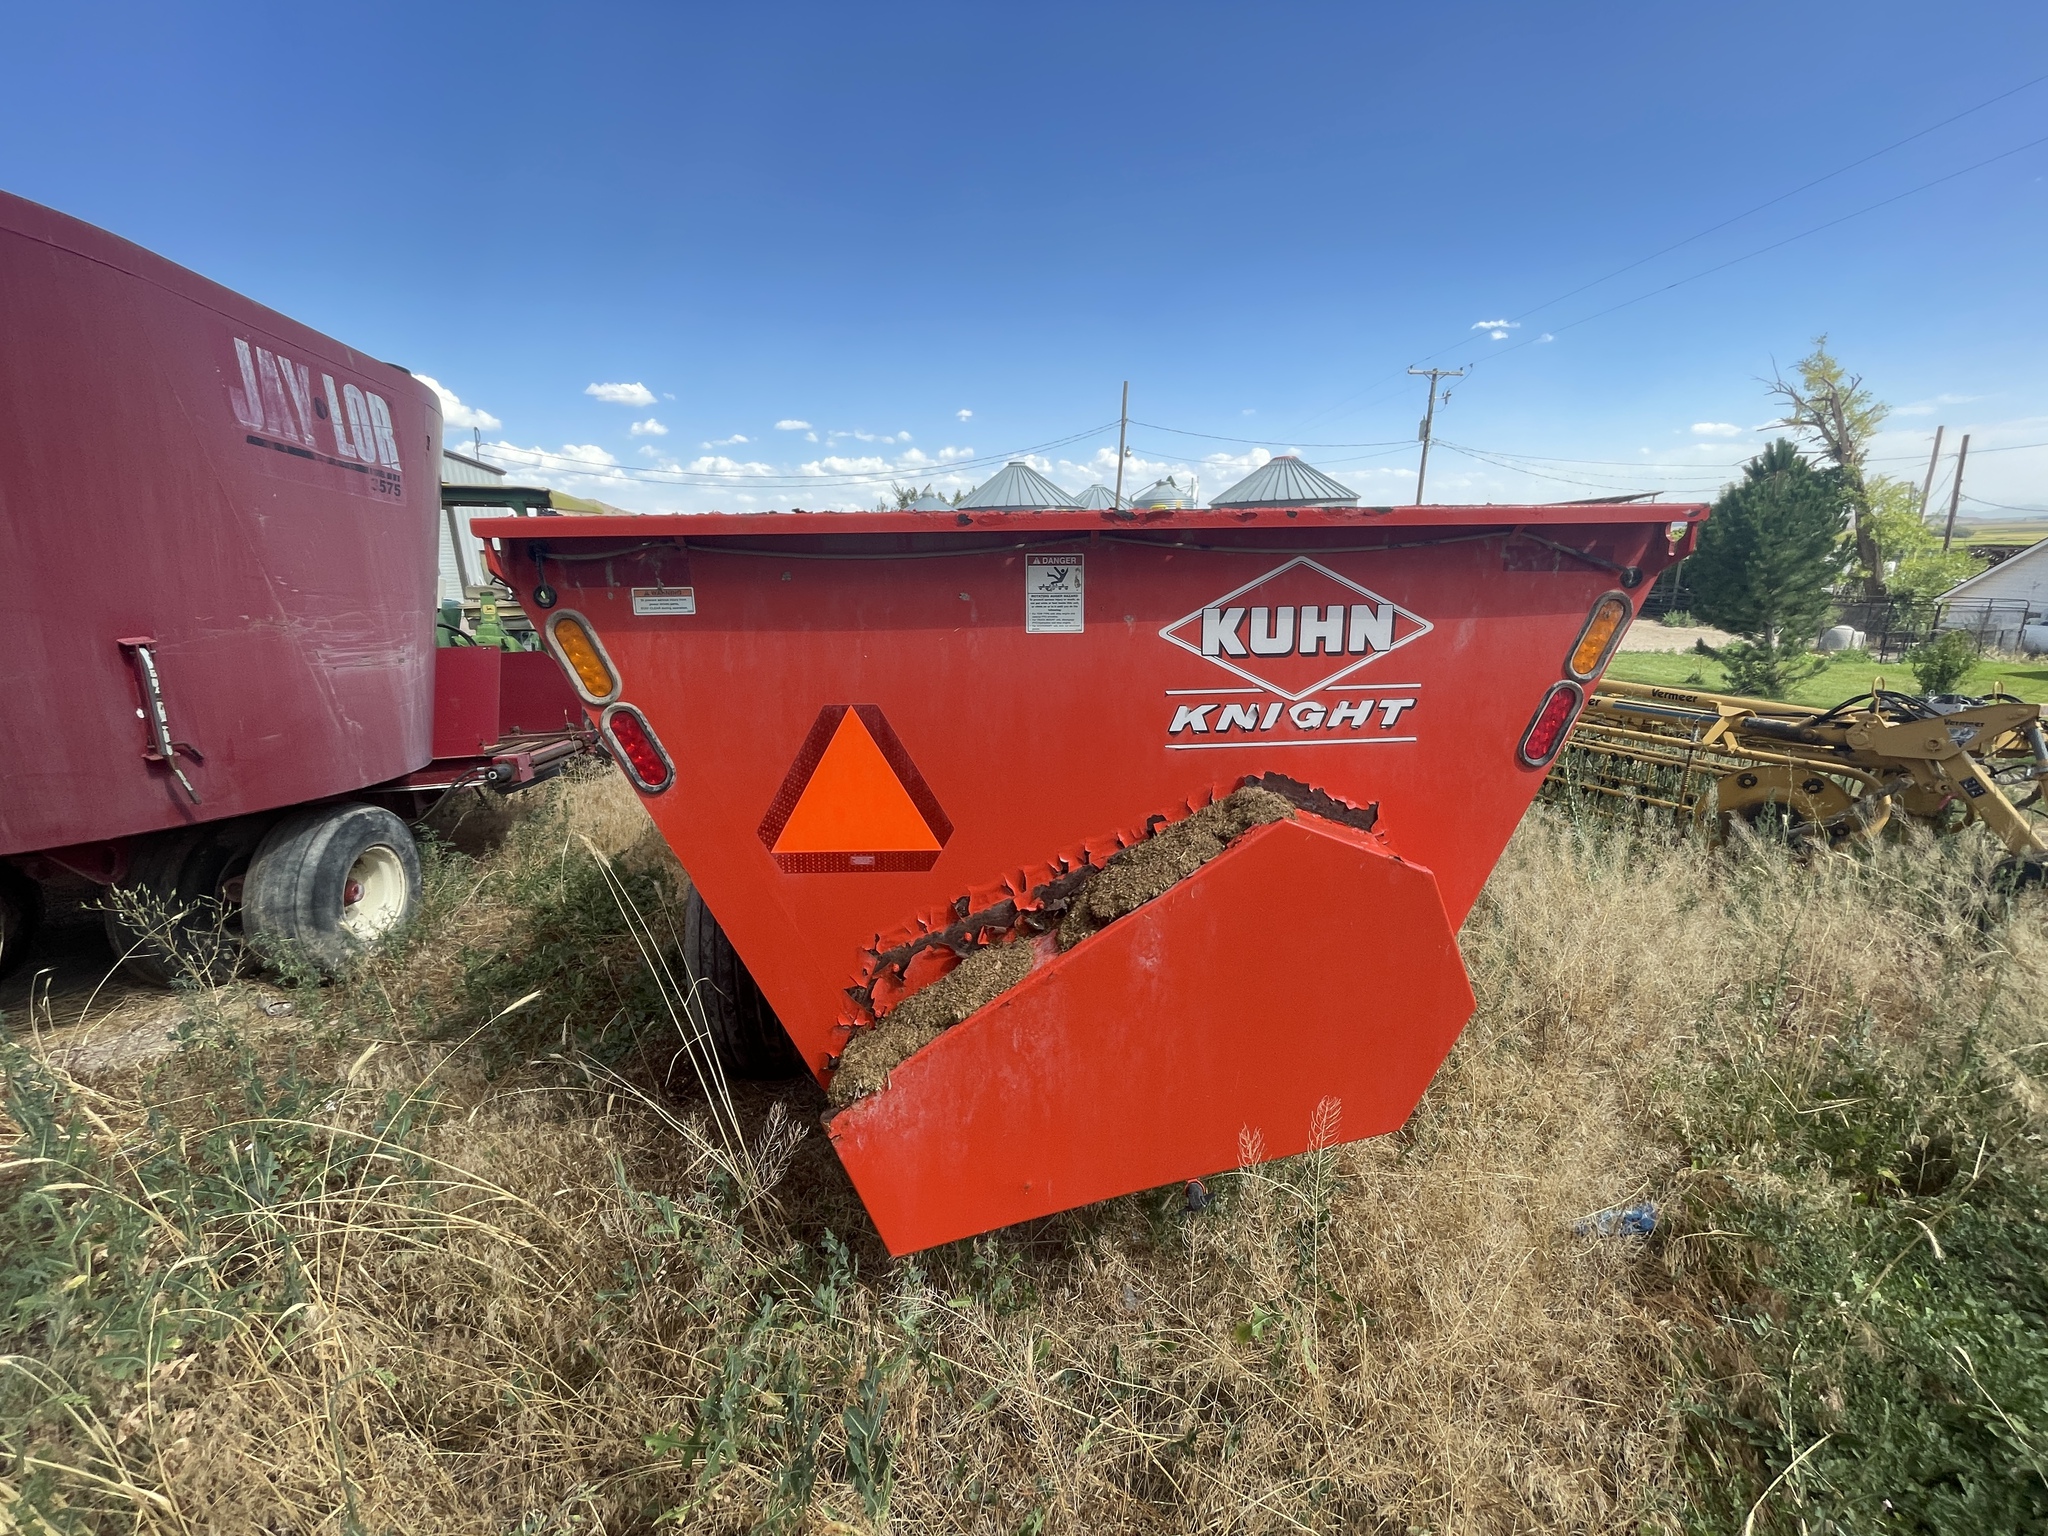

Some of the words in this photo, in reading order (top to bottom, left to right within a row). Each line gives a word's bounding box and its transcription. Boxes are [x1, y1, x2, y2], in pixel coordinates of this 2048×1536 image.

[228, 336, 316, 447] JAY
[321, 372, 402, 472] LOR
[1042, 556, 1077, 565] DANGER
[1200, 604, 1395, 659] KUHN
[1651, 688, 1698, 703] Vermeer
[1168, 698, 1417, 735] KNIGHT
[1943, 718, 1985, 728] Vermeer
